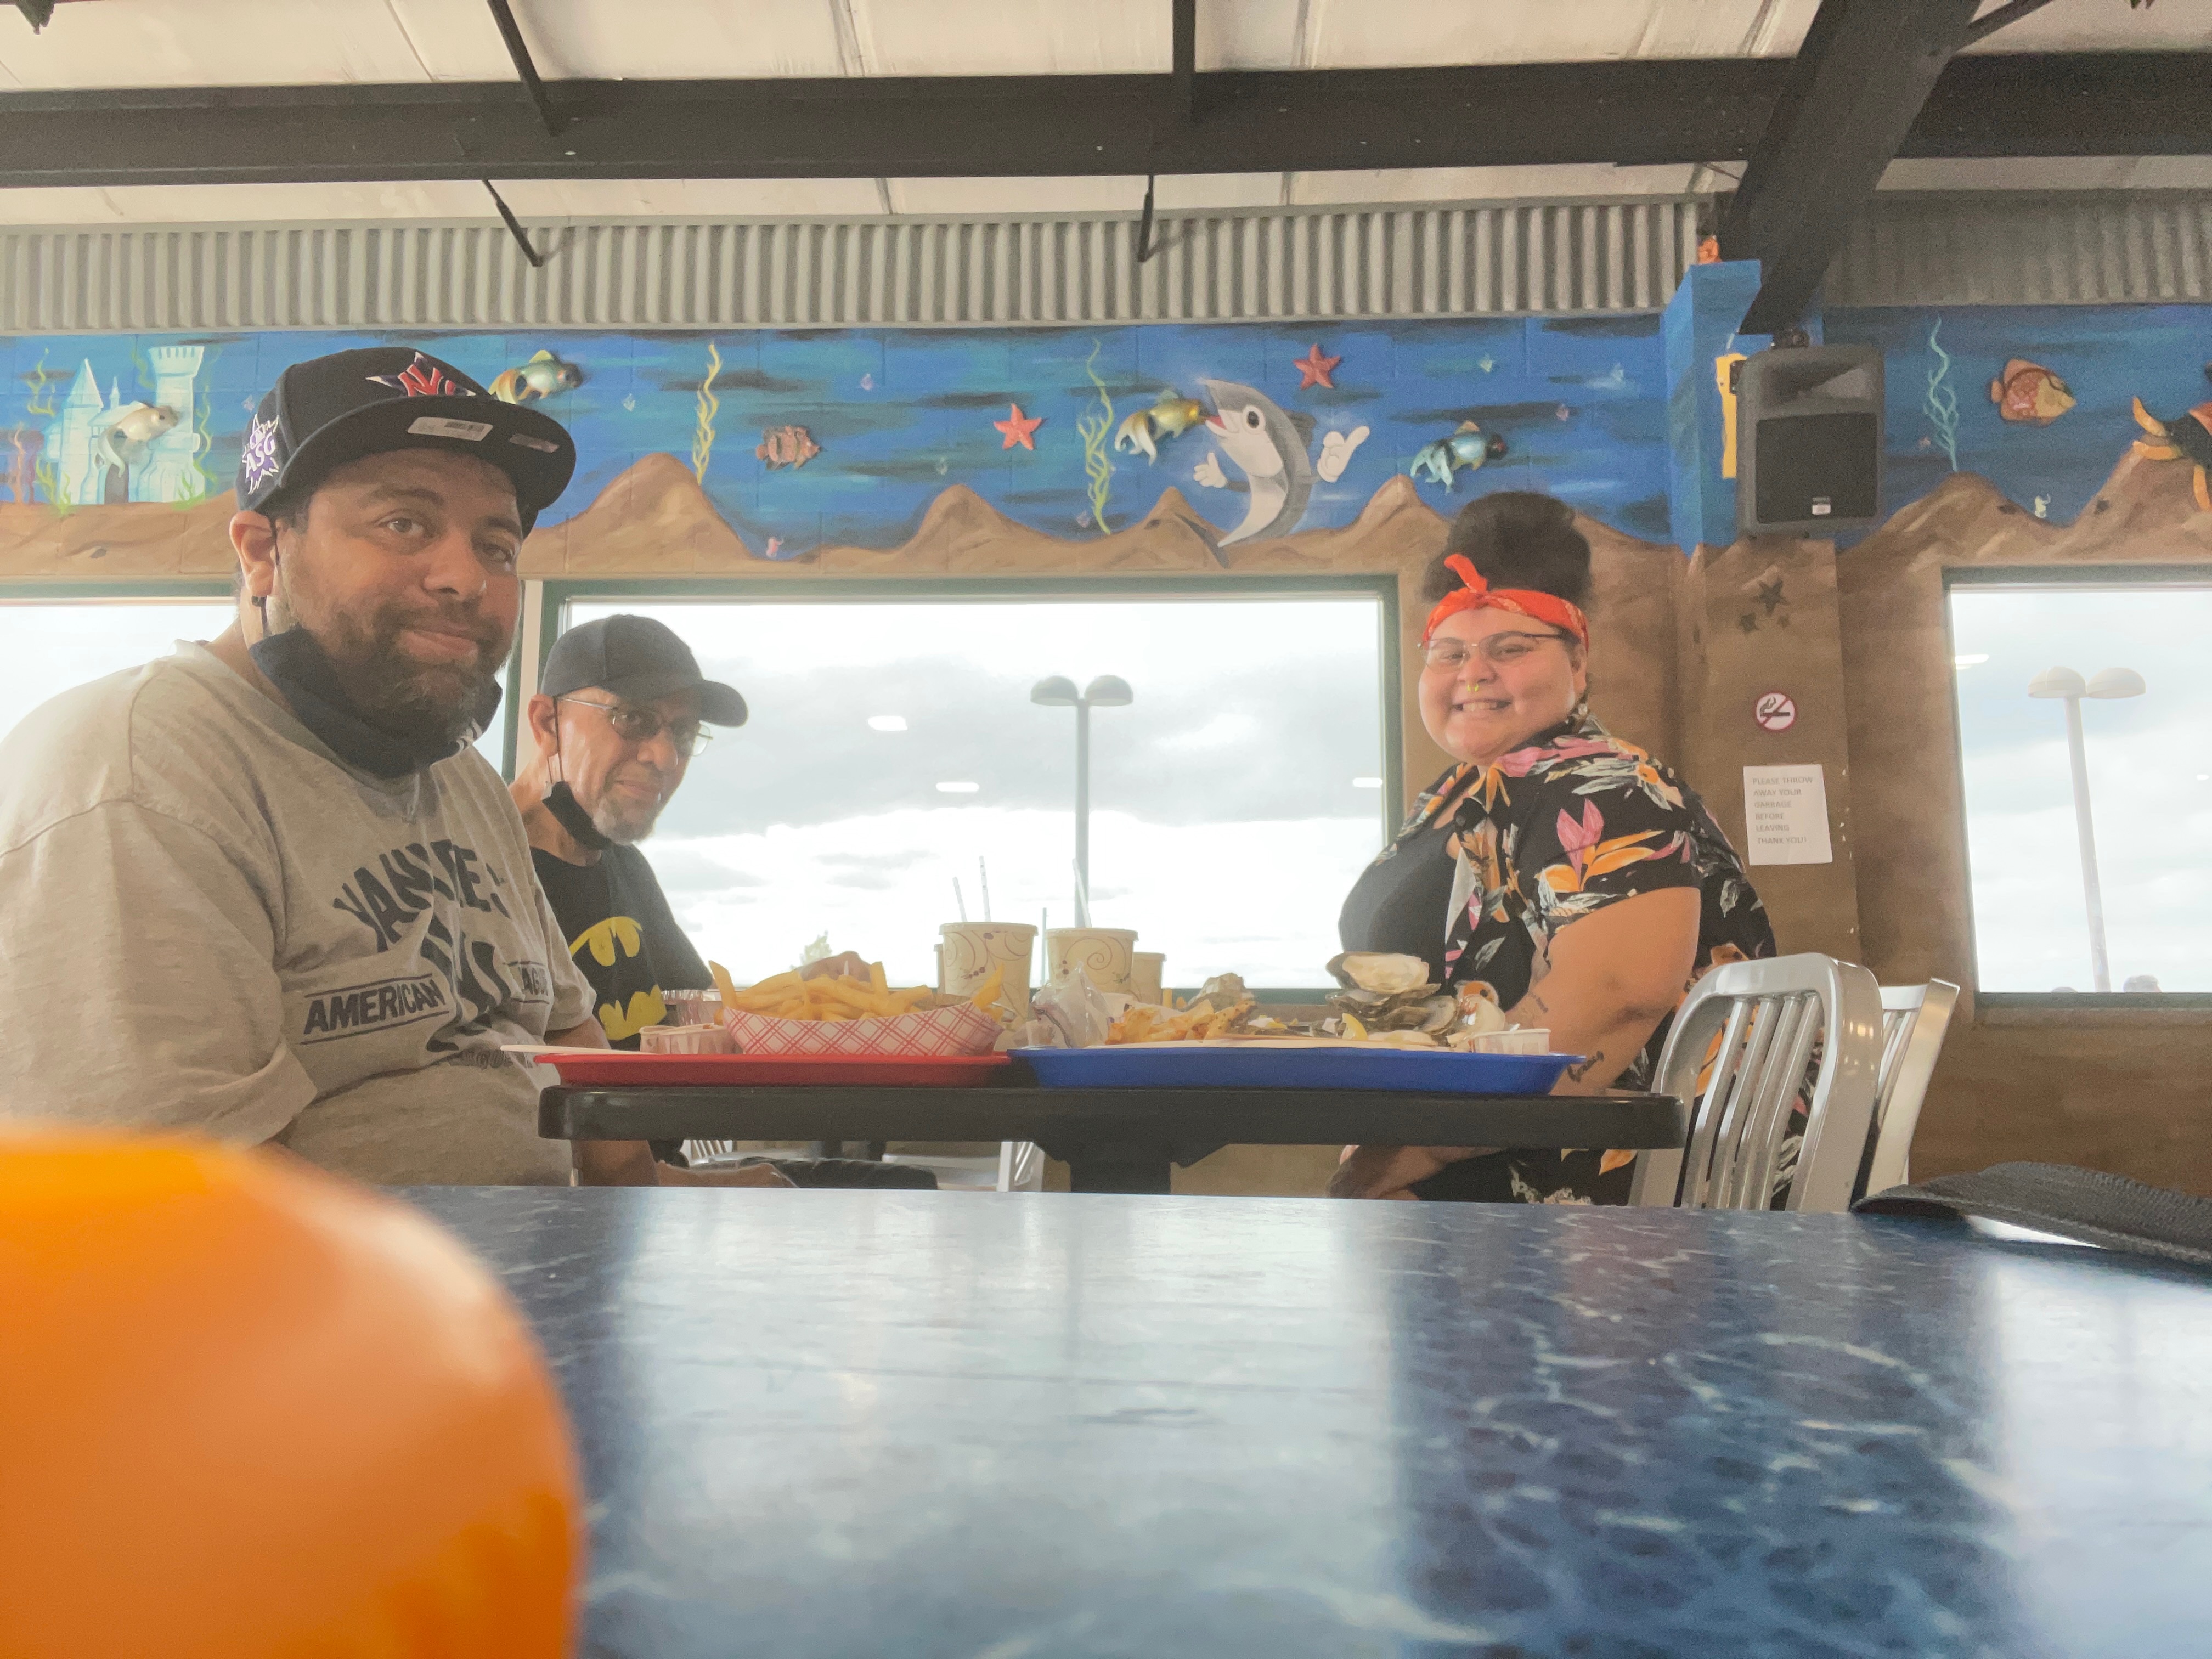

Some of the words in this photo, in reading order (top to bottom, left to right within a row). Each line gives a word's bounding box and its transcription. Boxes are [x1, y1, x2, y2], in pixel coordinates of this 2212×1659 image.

[246, 431, 276, 478] ASG
[1752, 777, 1780, 785] PLEASE
[303, 979, 446, 1035] AMERICAN
